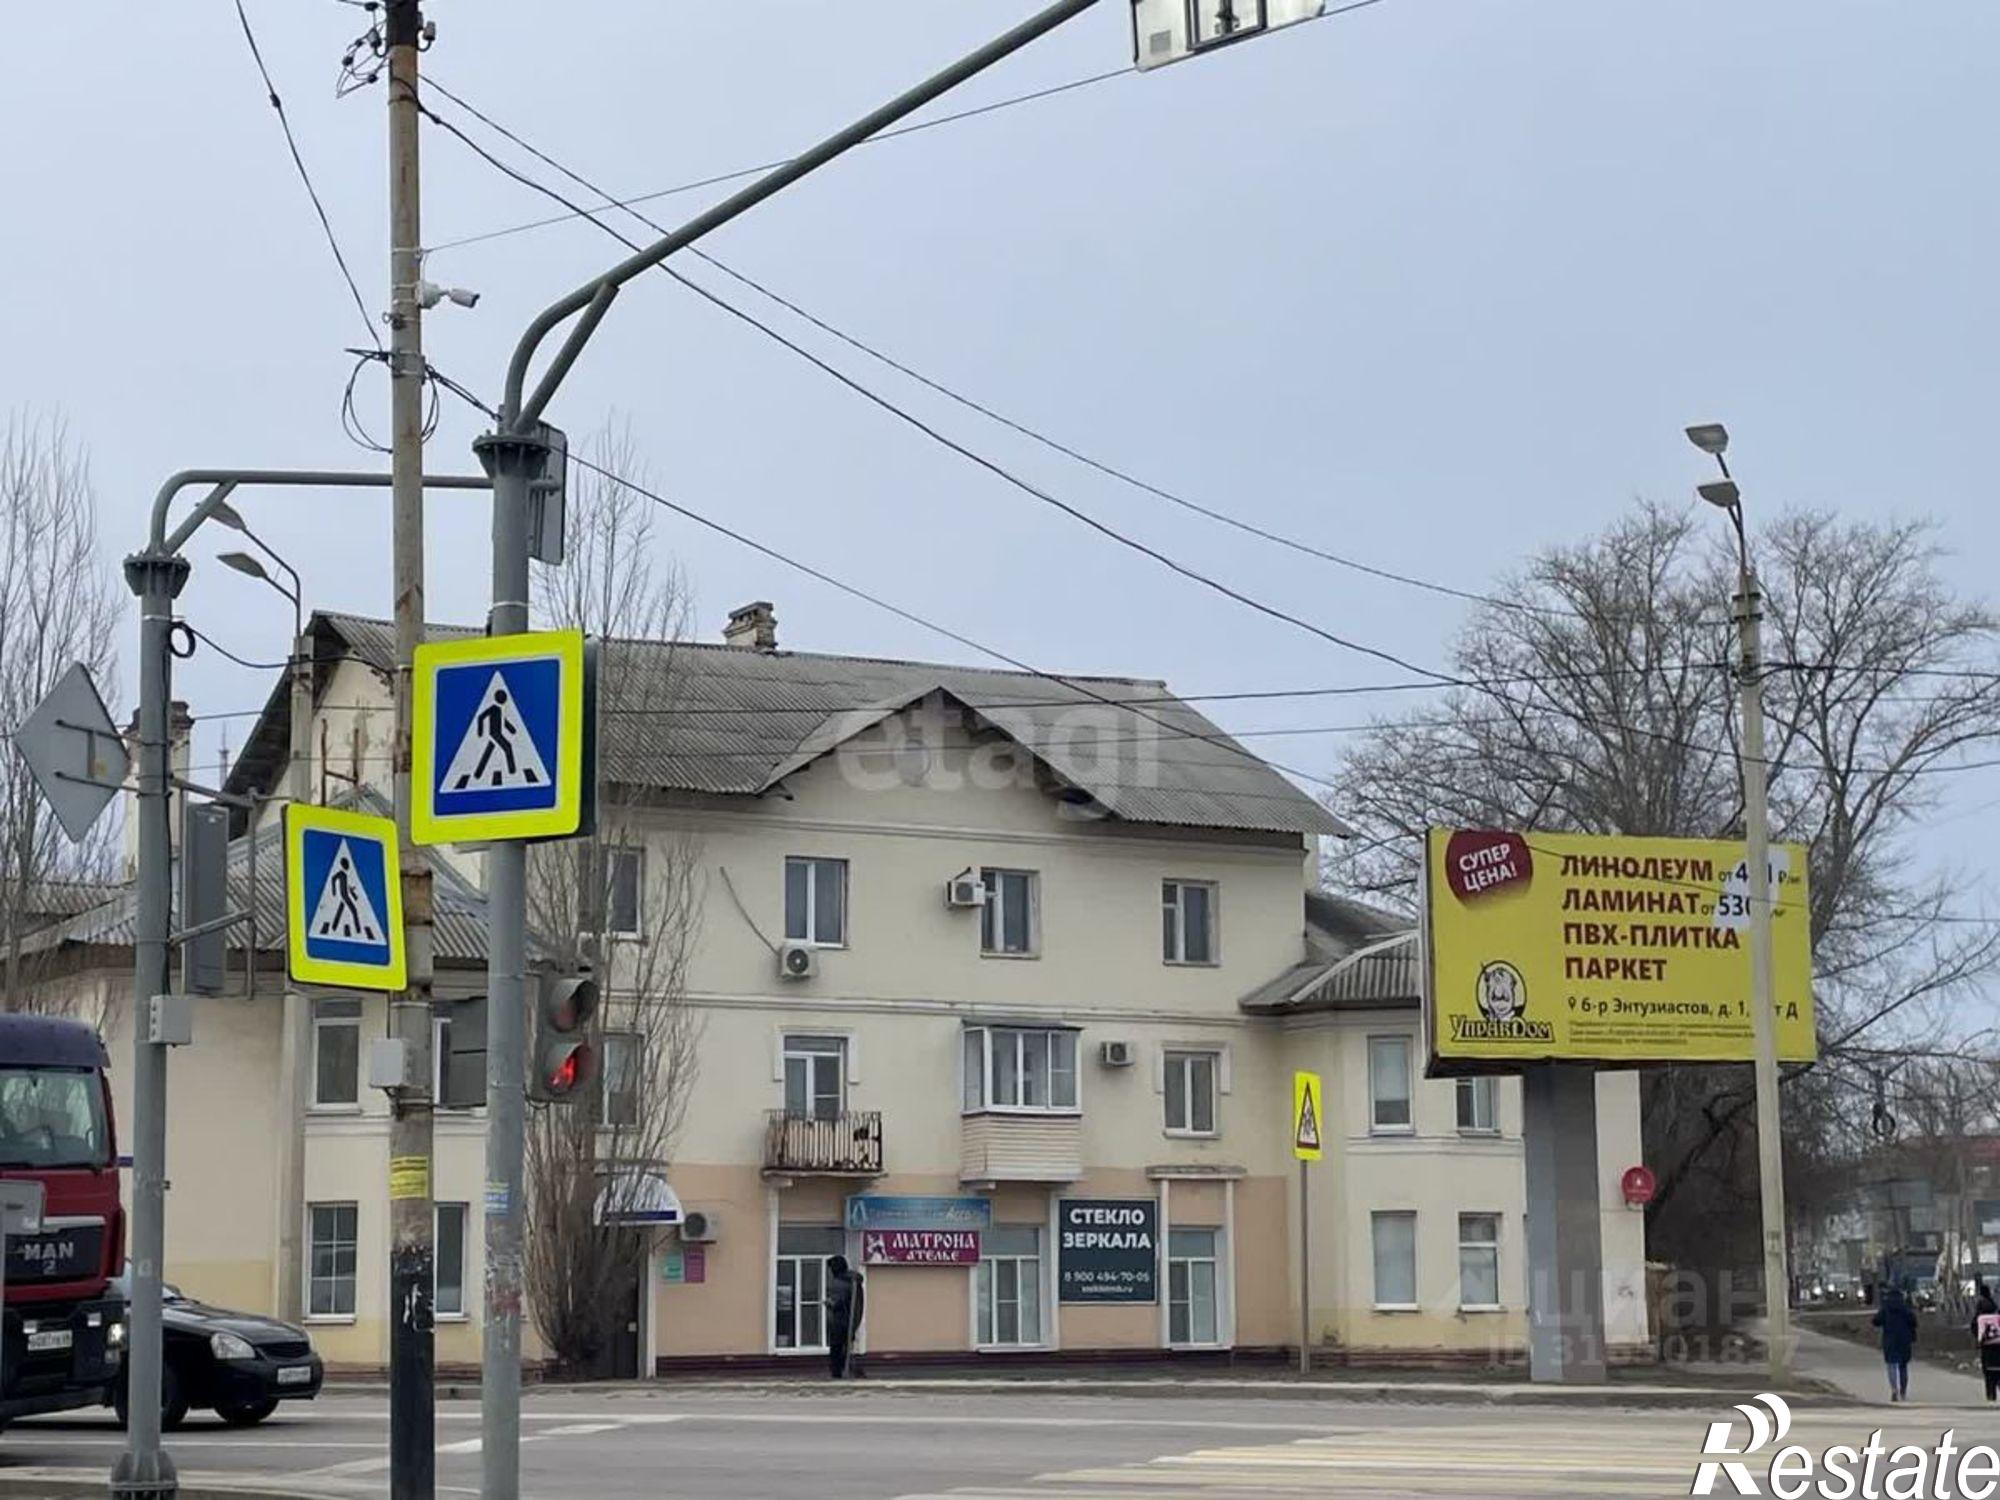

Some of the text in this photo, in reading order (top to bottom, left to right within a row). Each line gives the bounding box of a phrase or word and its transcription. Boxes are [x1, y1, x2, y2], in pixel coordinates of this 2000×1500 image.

[1459, 843, 1511, 872] СУПЕР
[1560, 855, 1713, 881] ЛИНОЛЕУМ
[1718, 871, 1733, 883] от
[1735, 862, 1773, 884] 41
[1463, 861, 1518, 892] ЦЕНА!
[1562, 888, 1700, 914] ЛАМИНАТ
[1701, 903, 1715, 915] от
[1563, 922, 1740, 949] ПВХ-ПЛИТКА
[1565, 957, 1667, 981] ПАРКЕТ
[1612, 997, 1713, 1018] Энтузиастов,
[1718, 1003, 1732, 1018] д.
[1070, 1207, 1146, 1225] СТЕКЛО
[24, 1242, 74, 1260] MAN
[892, 1232, 976, 1250] МАТРОНА
[1063, 1231, 1152, 1249] ЗЕРКАЛА
